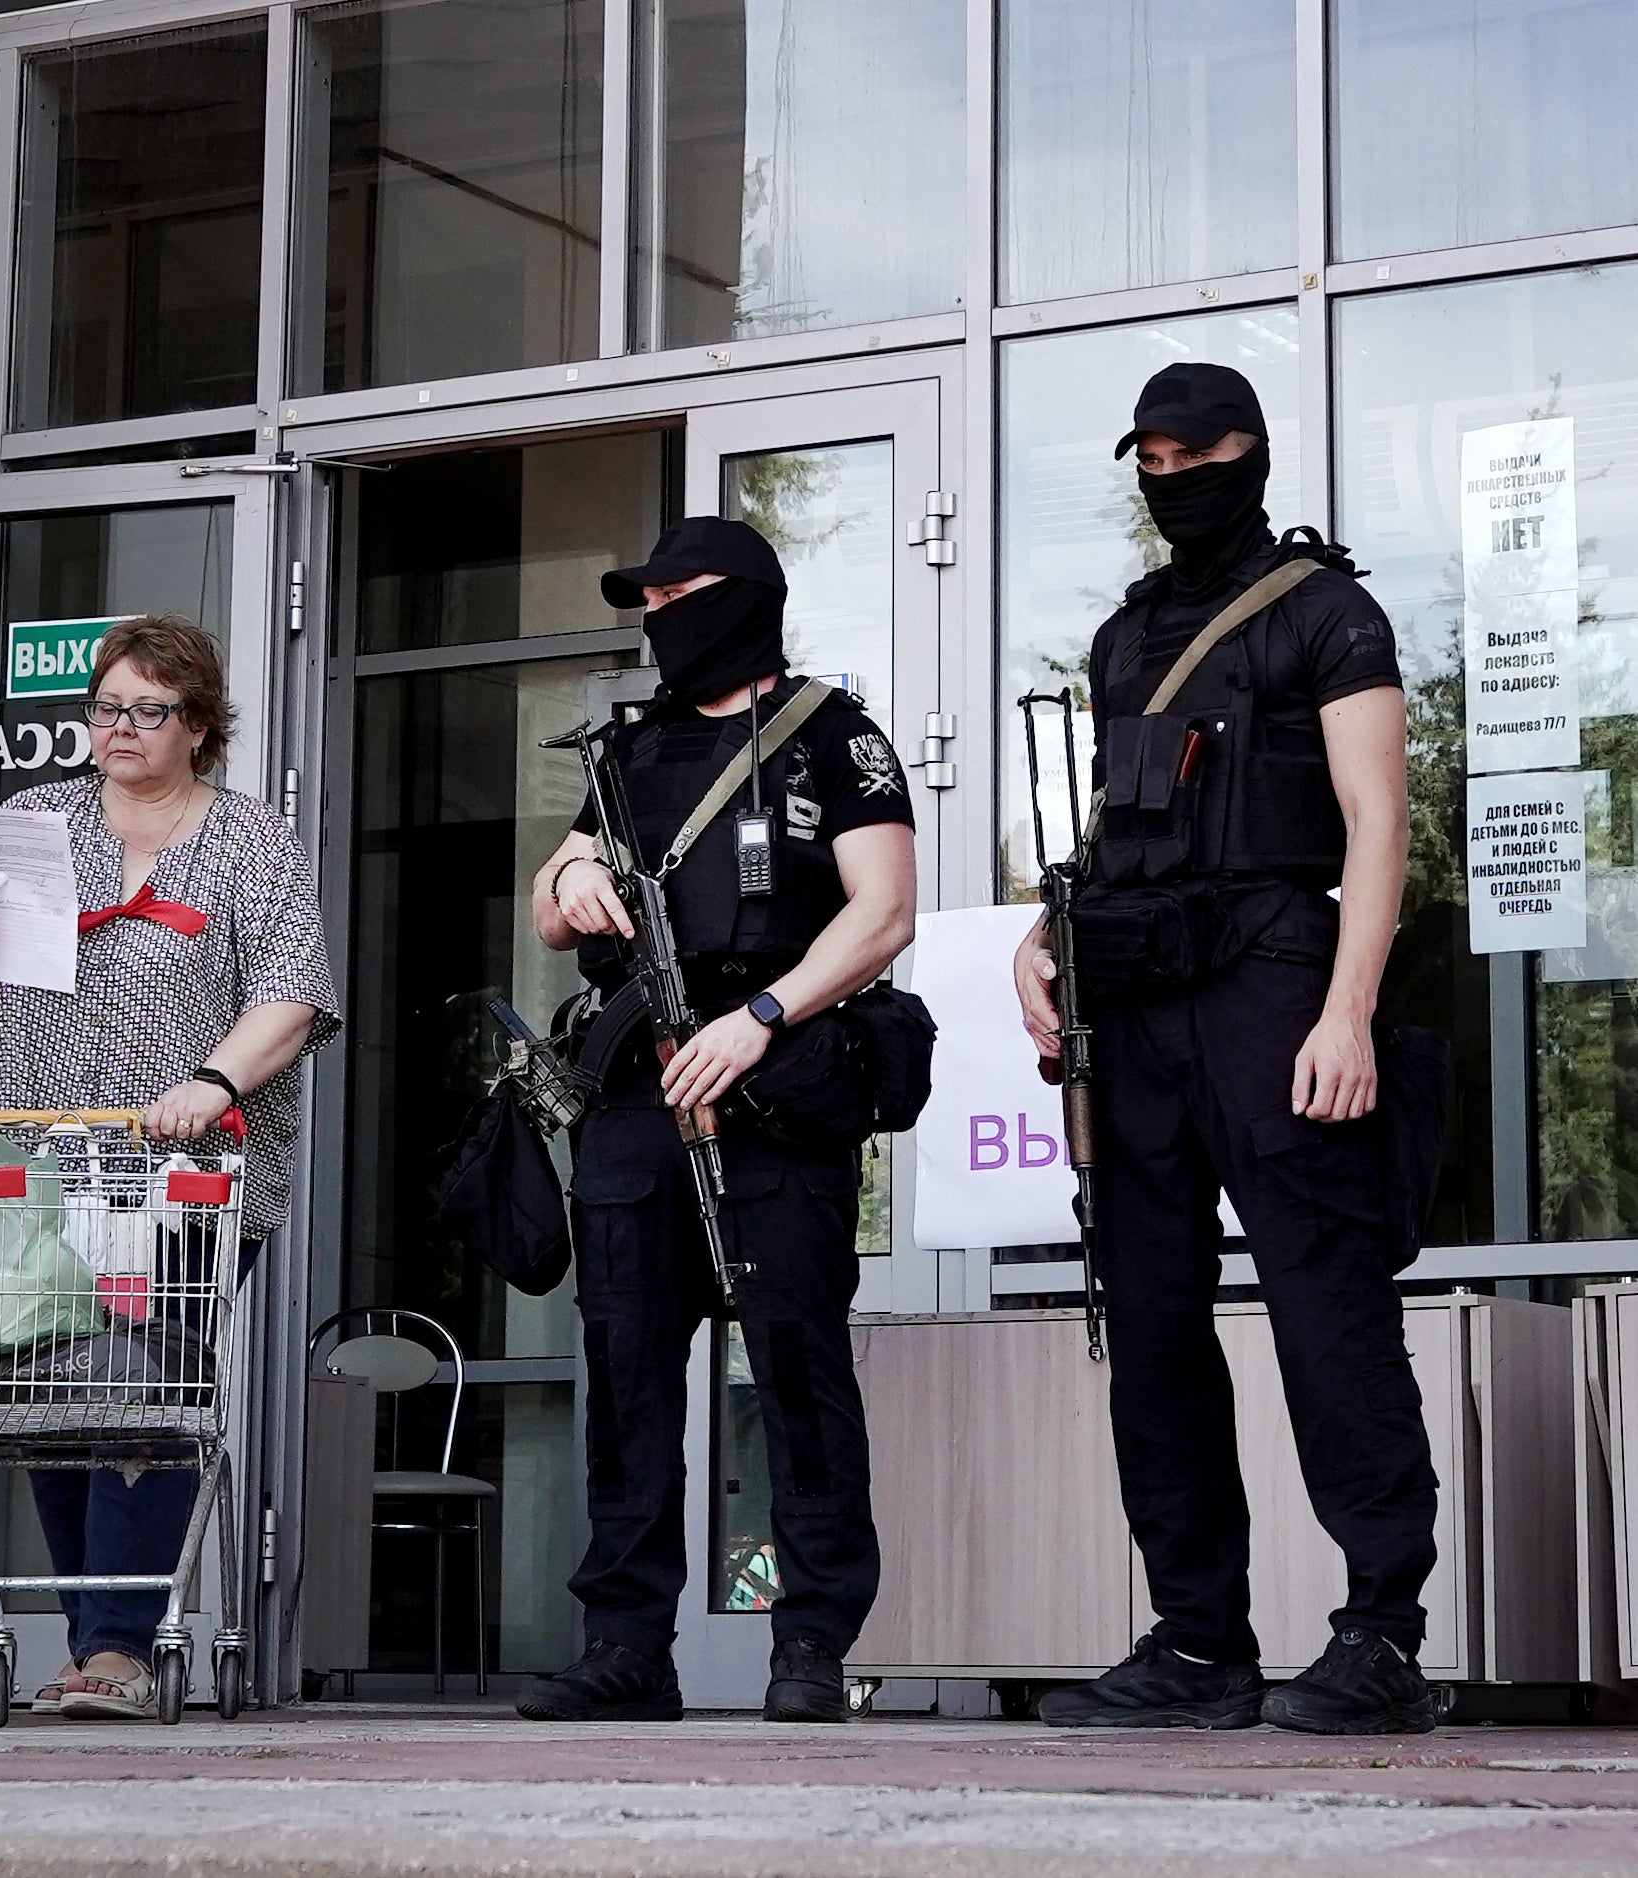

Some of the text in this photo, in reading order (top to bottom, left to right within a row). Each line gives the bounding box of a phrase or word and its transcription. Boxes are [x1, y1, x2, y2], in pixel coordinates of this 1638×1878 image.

[1489, 453, 1542, 472] ВЫДАЧИ
[1467, 469, 1567, 494] ЛЕКАРСТВЕННЫХ
[1489, 491, 1542, 510] СРЕДСТВ
[1491, 515, 1545, 553] НЕТ
[1488, 630, 1548, 647] Выдача
[1484, 652, 1555, 670] лекарств
[1481, 674, 1560, 693] по адресу:
[1476, 716, 1567, 736] Радищева 77/7
[1485, 801, 1564, 821] ДЛЯ СЕМЕЙ С
[1471, 821, 1582, 842] ДЕТЬМИ ДО 6 МЕС.
[1492, 838, 1558, 857] И ЛЮДЕЙ С
[1472, 859, 1581, 878] ИНВАЛИДНОСТЬЮ
[1490, 878, 1561, 896] ОТДЕЛЬНАЯ
[1499, 899, 1552, 915] ОЧЕРЕДЬ
